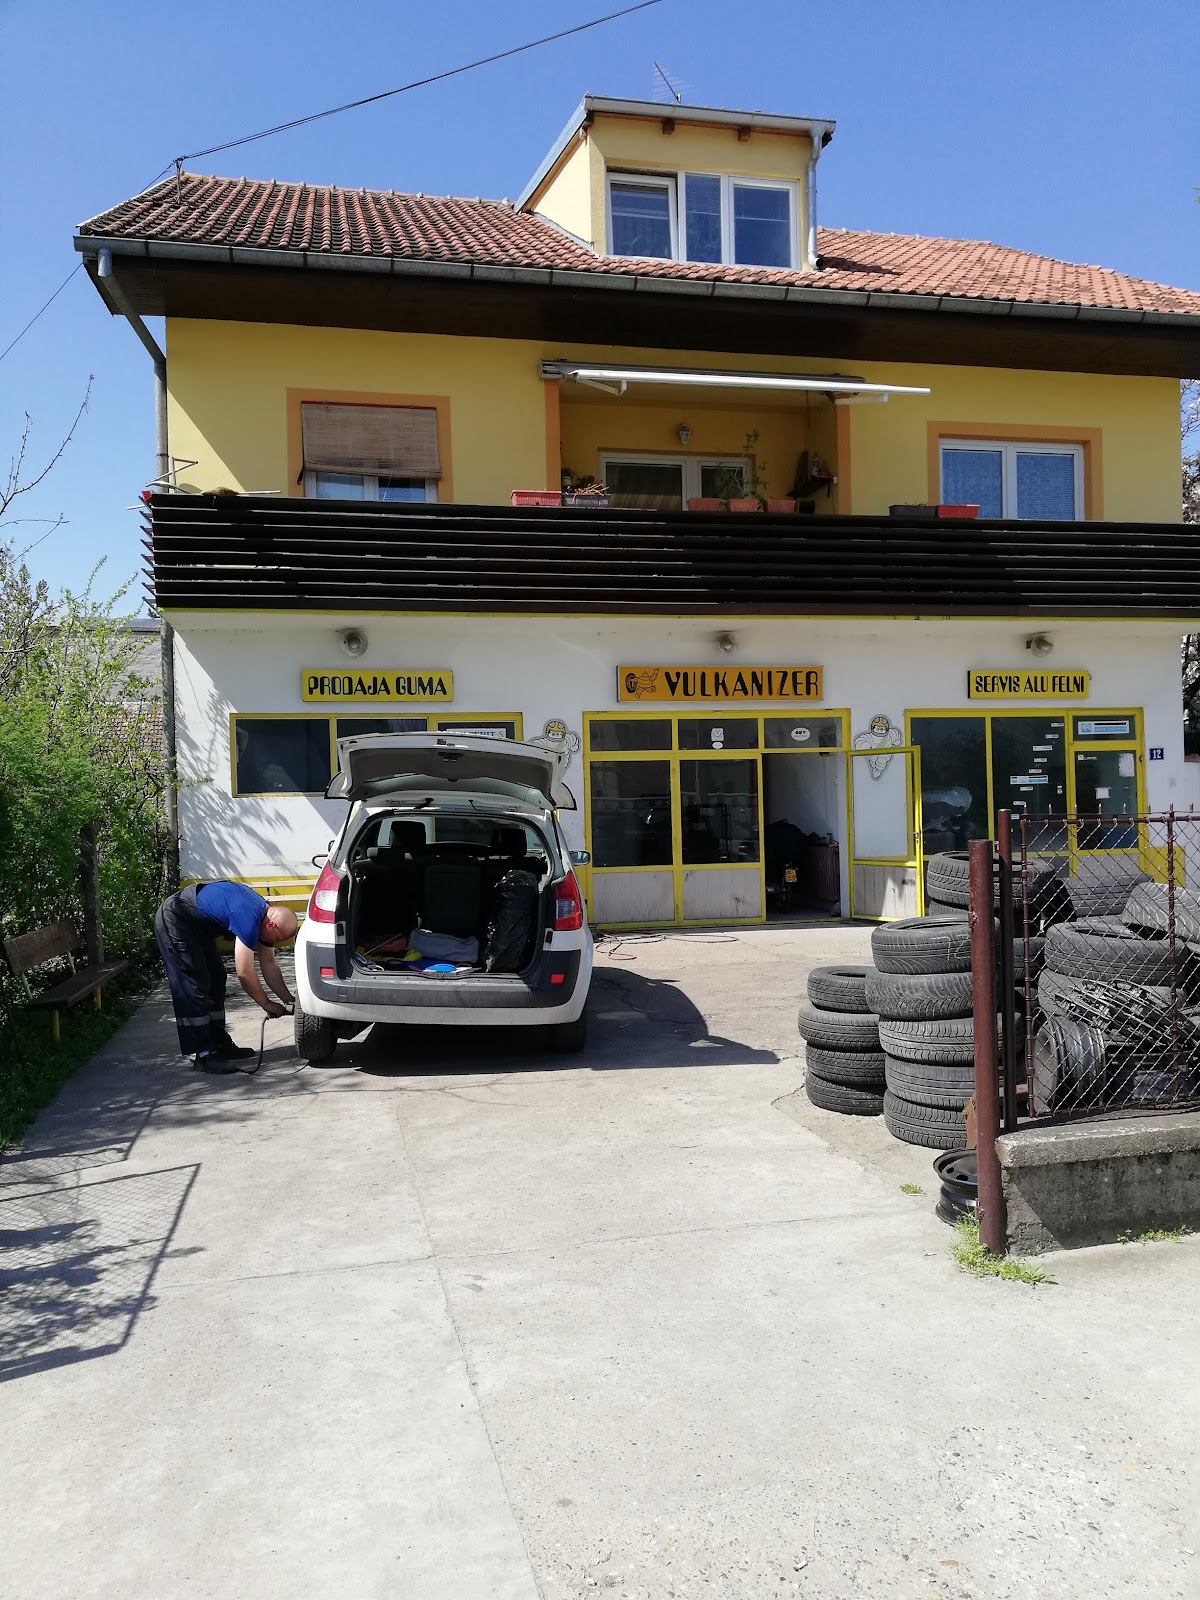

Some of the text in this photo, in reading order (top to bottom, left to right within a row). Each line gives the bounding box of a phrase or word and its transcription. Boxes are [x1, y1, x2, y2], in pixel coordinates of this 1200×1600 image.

[307, 676, 448, 695] PRODAJA GUMA
[664, 670, 819, 697] VULKANIZER
[975, 675, 1085, 693] SERVIS ALU FELNI
[1152, 749, 1162, 759] 12
